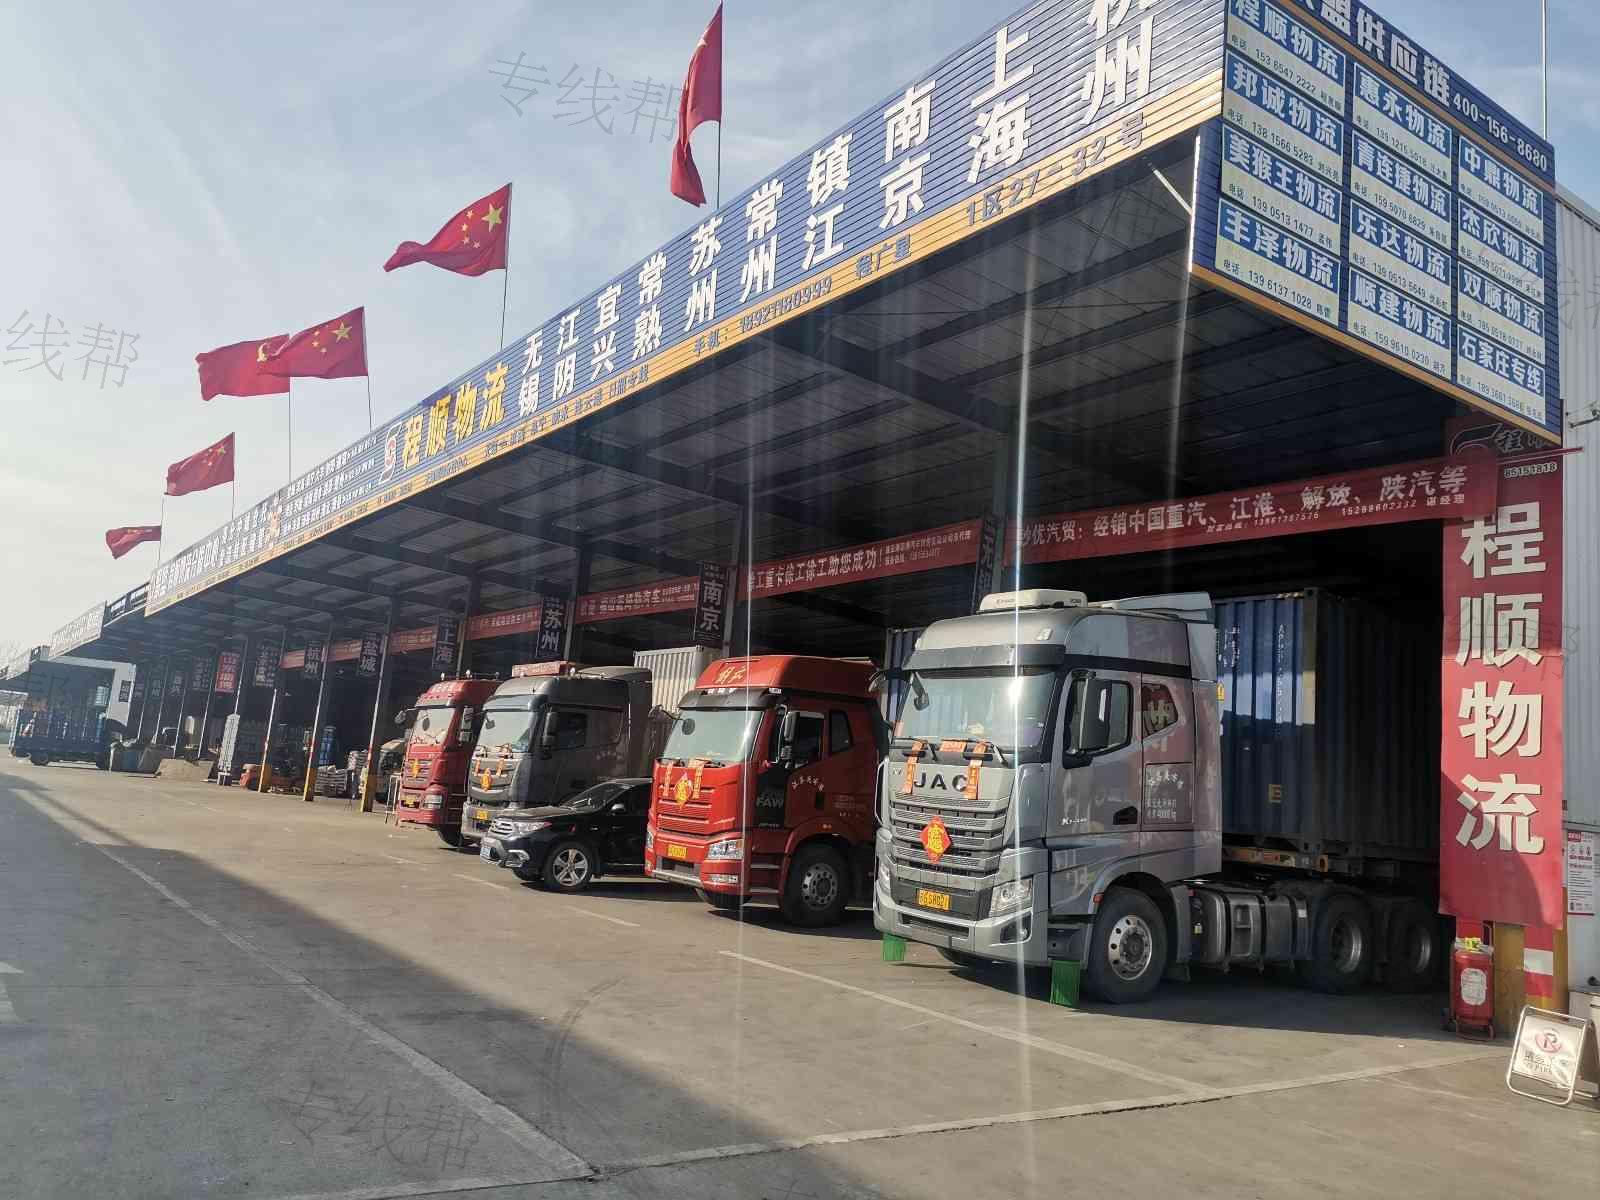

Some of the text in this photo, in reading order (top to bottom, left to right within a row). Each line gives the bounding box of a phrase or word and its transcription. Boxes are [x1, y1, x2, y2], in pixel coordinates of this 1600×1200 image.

[967, 25, 1035, 184] 上海
[1232, 62, 1338, 150] 邦诚物流
[1304, 0, 1547, 172] 盟供应链 400-156-8680
[879, 79, 937, 230] 南京
[1229, 128, 1336, 219] 美猴王物流
[739, 178, 785, 304] 常州
[802, 132, 855, 271] 镇江
[1356, 207, 1446, 281] 乐达物流
[685, 215, 725, 334] 苏州
[1224, 207, 1334, 289] 丰泽物流
[590, 283, 622, 382] 宜兴
[632, 252, 668, 361] 常熟
[1355, 274, 1446, 345] 顺建物流
[1463, 269, 1541, 335] 双顺物流
[518, 328, 544, 418] 无锡
[553, 306, 582, 402] 江阴
[1461, 330, 1542, 394] 石家庄专线
[541, 608, 565, 651] 苏州
[702, 579, 724, 632] 南京
[1449, 501, 1546, 856] 程顺物流
[756, 794, 784, 808] FAW
[913, 772, 968, 793] JAC
